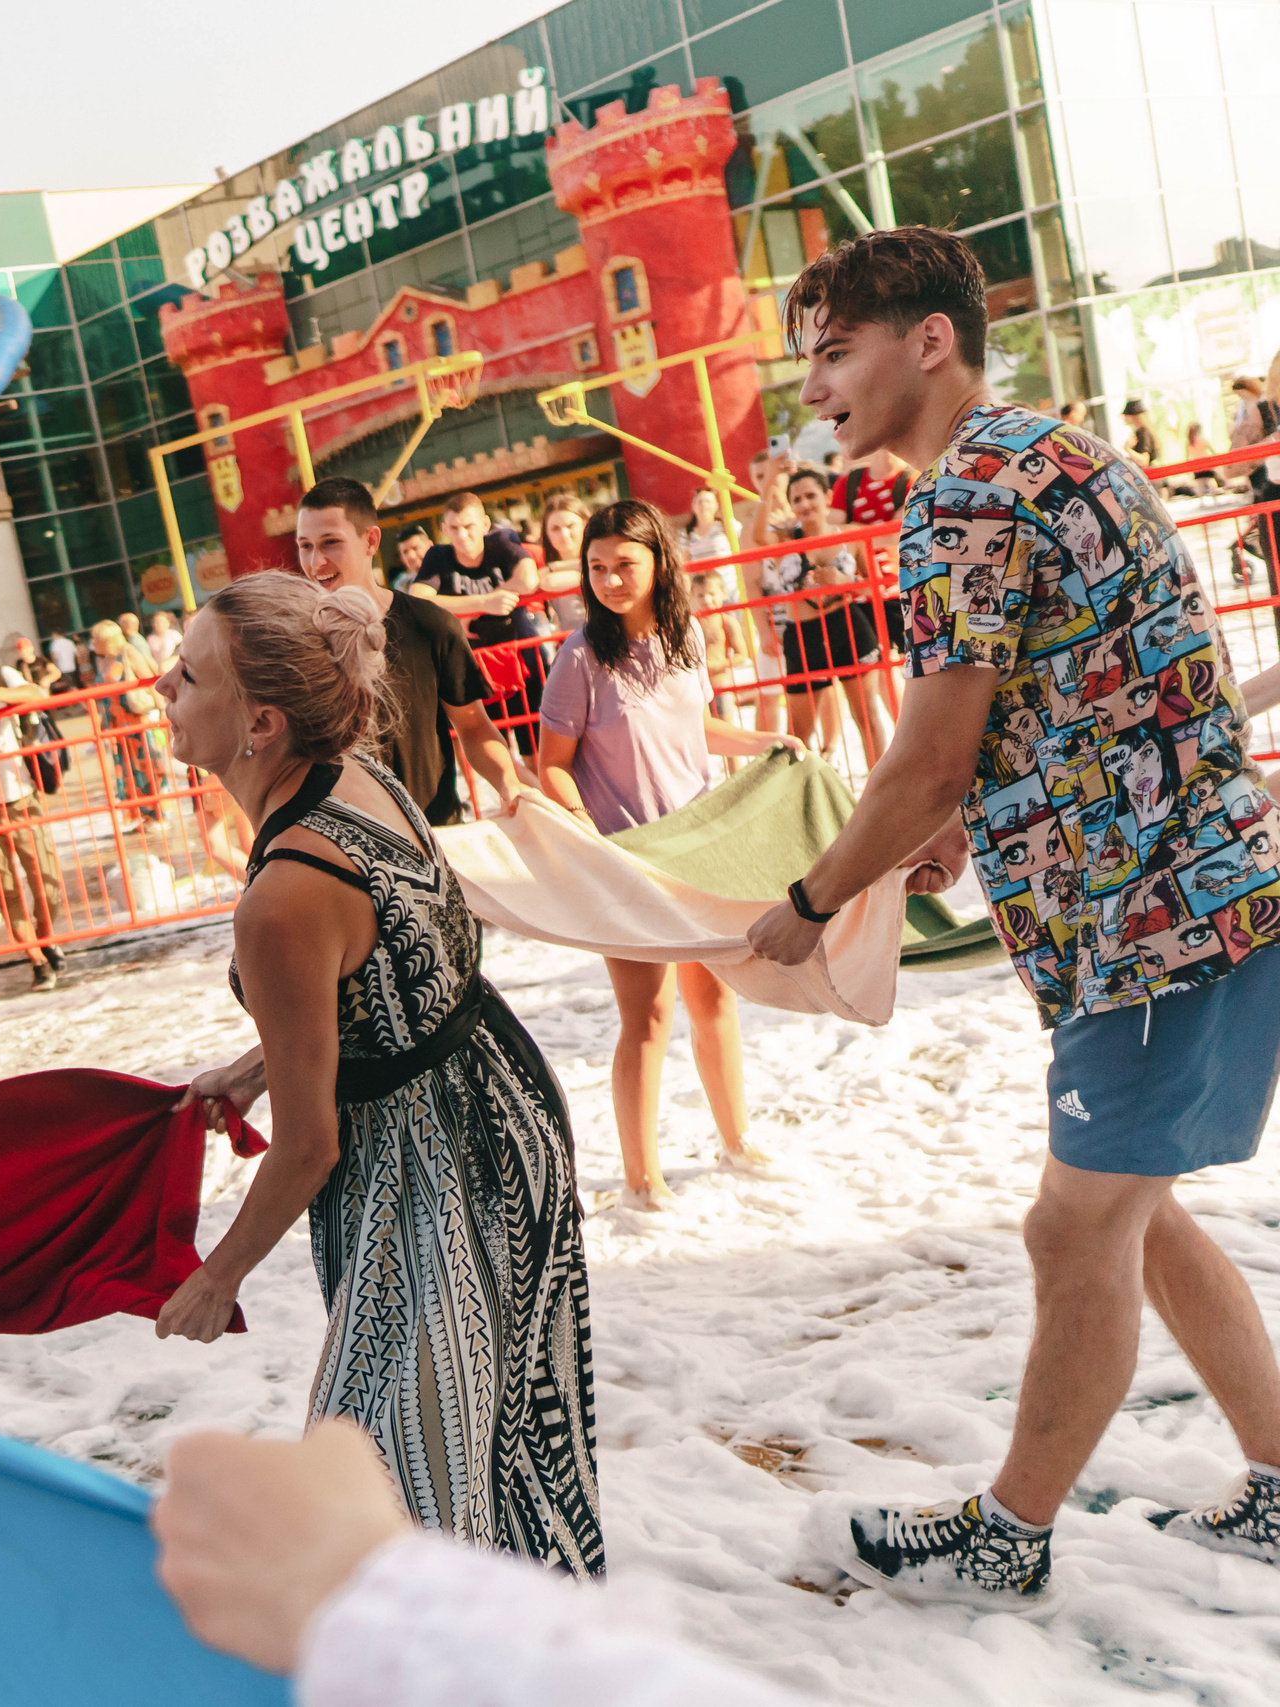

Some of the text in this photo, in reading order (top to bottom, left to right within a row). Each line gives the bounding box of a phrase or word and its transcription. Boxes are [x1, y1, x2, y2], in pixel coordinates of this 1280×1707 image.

[183, 66, 552, 288] РОЗВАЖАЛЬНИЙ
[293, 169, 431, 271] ЦЕНТР
[1103, 748, 1126, 767] OMG
[1056, 1099, 1091, 1122] adidas
